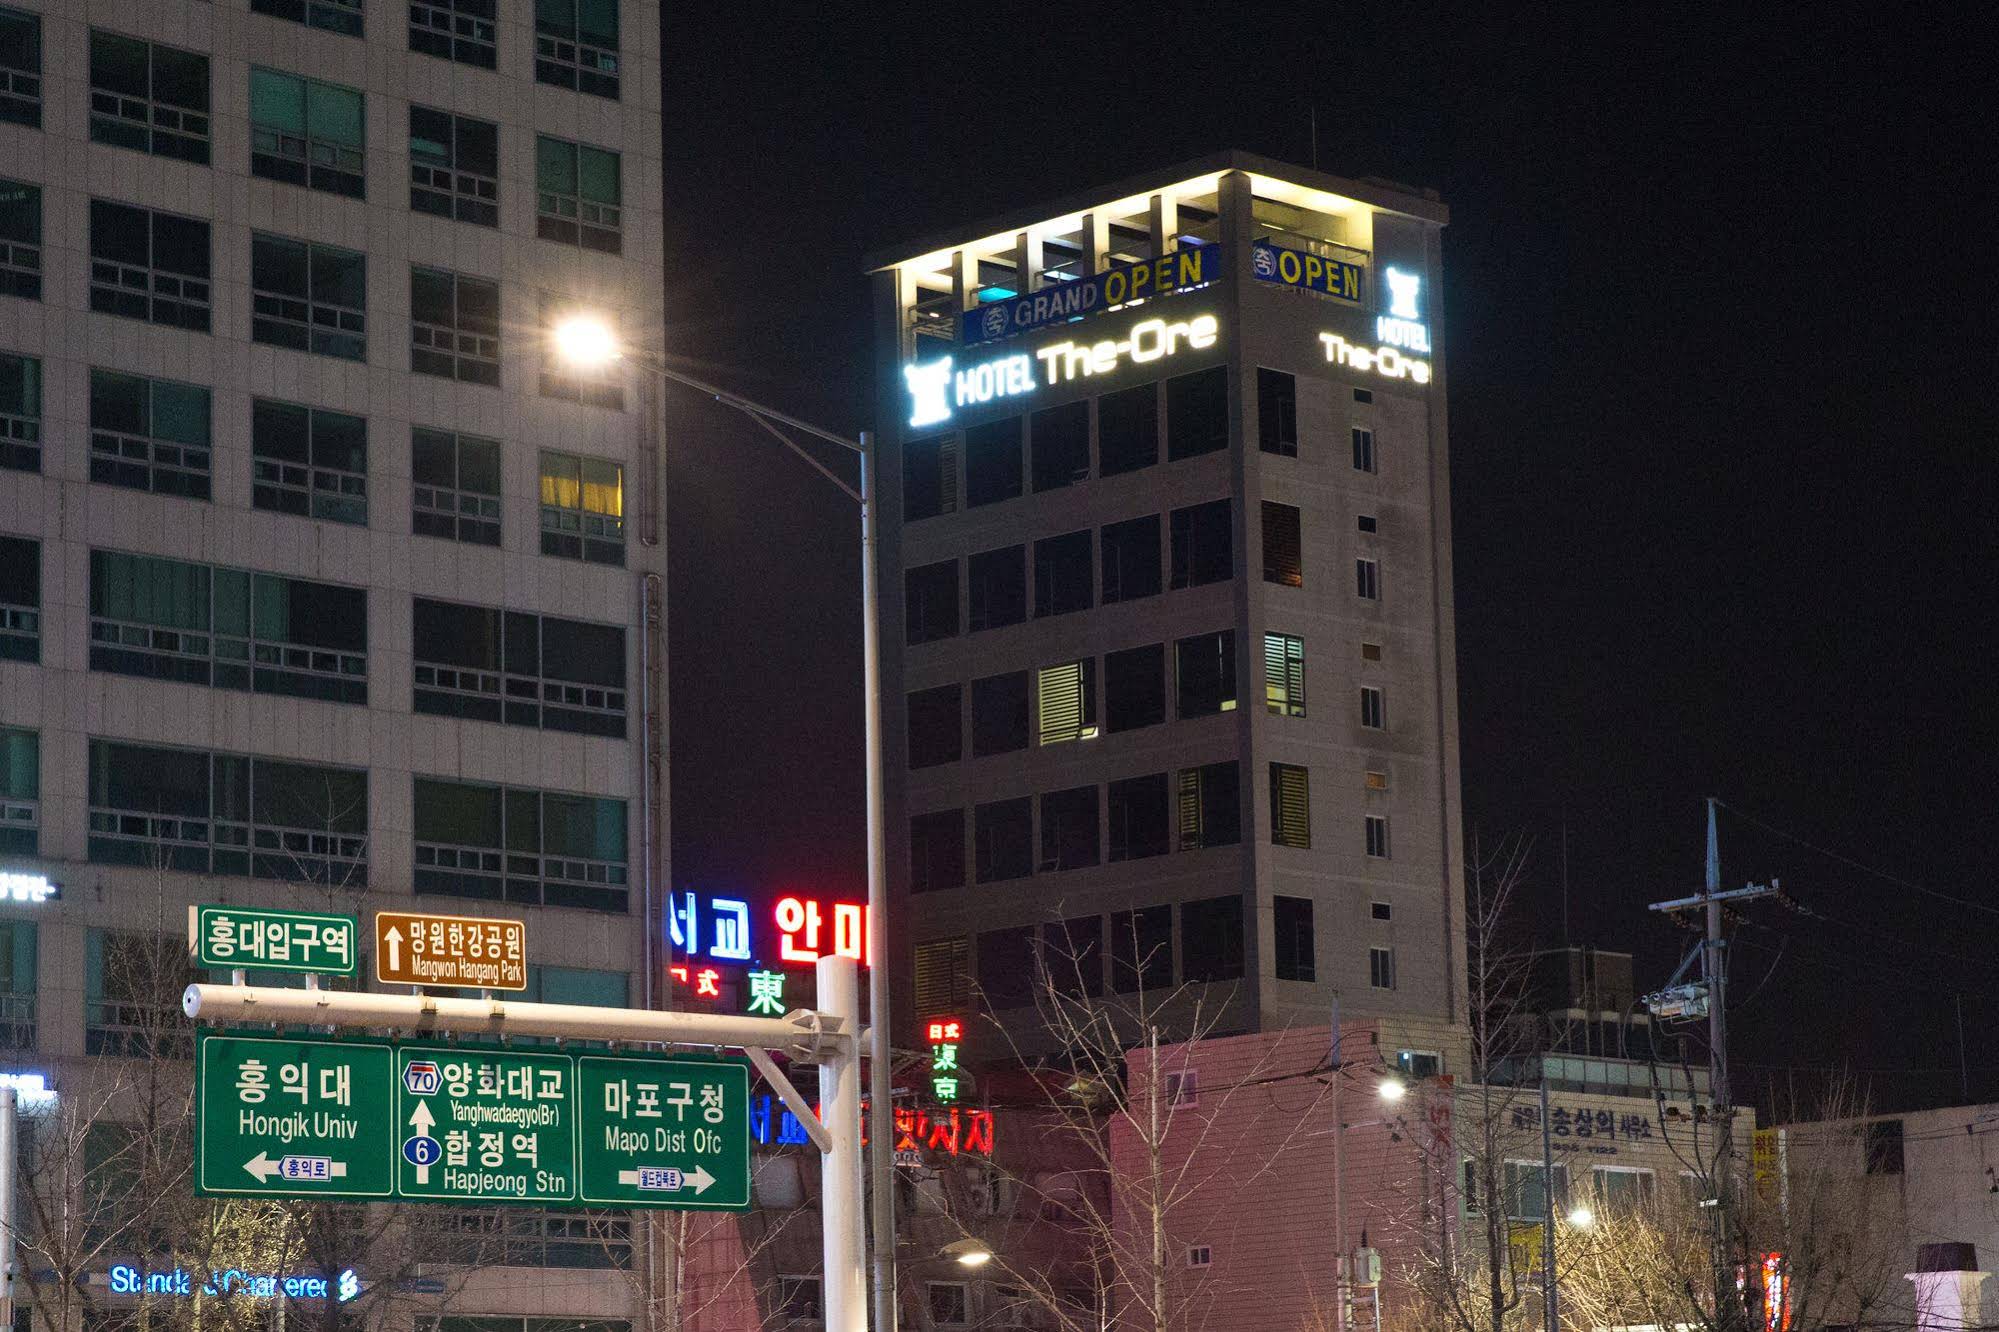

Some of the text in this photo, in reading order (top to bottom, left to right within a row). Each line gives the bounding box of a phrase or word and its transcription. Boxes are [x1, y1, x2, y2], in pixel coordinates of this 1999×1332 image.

[1014, 249, 1202, 326] GRAND OPEN
[1279, 250, 1359, 300] OPEN
[1376, 315, 1431, 352] HOTEL
[955, 354, 1036, 407] HOTEL
[208, 916, 349, 964] 홍대입구역
[410, 920, 521, 960] 망원한강공원
[412, 954, 522, 986] Mangwon Hangang Park
[671, 968, 719, 996] 式
[235, 1058, 351, 1107] 홍익대
[412, 1073, 434, 1090] 70
[443, 1062, 565, 1101] 양화대교
[450, 1099, 560, 1128] Yanghwadaegyo(Br)
[604, 1079, 724, 1124] 마포구청
[239, 1108, 358, 1143] Hongik Univ
[605, 1125, 722, 1157] Mapo Dist Ofc
[288, 1158, 326, 1178] 홍익로
[415, 1139, 429, 1163] 6
[444, 1130, 538, 1169] 합정역
[444, 1168, 565, 1196] Hapjeong Stn
